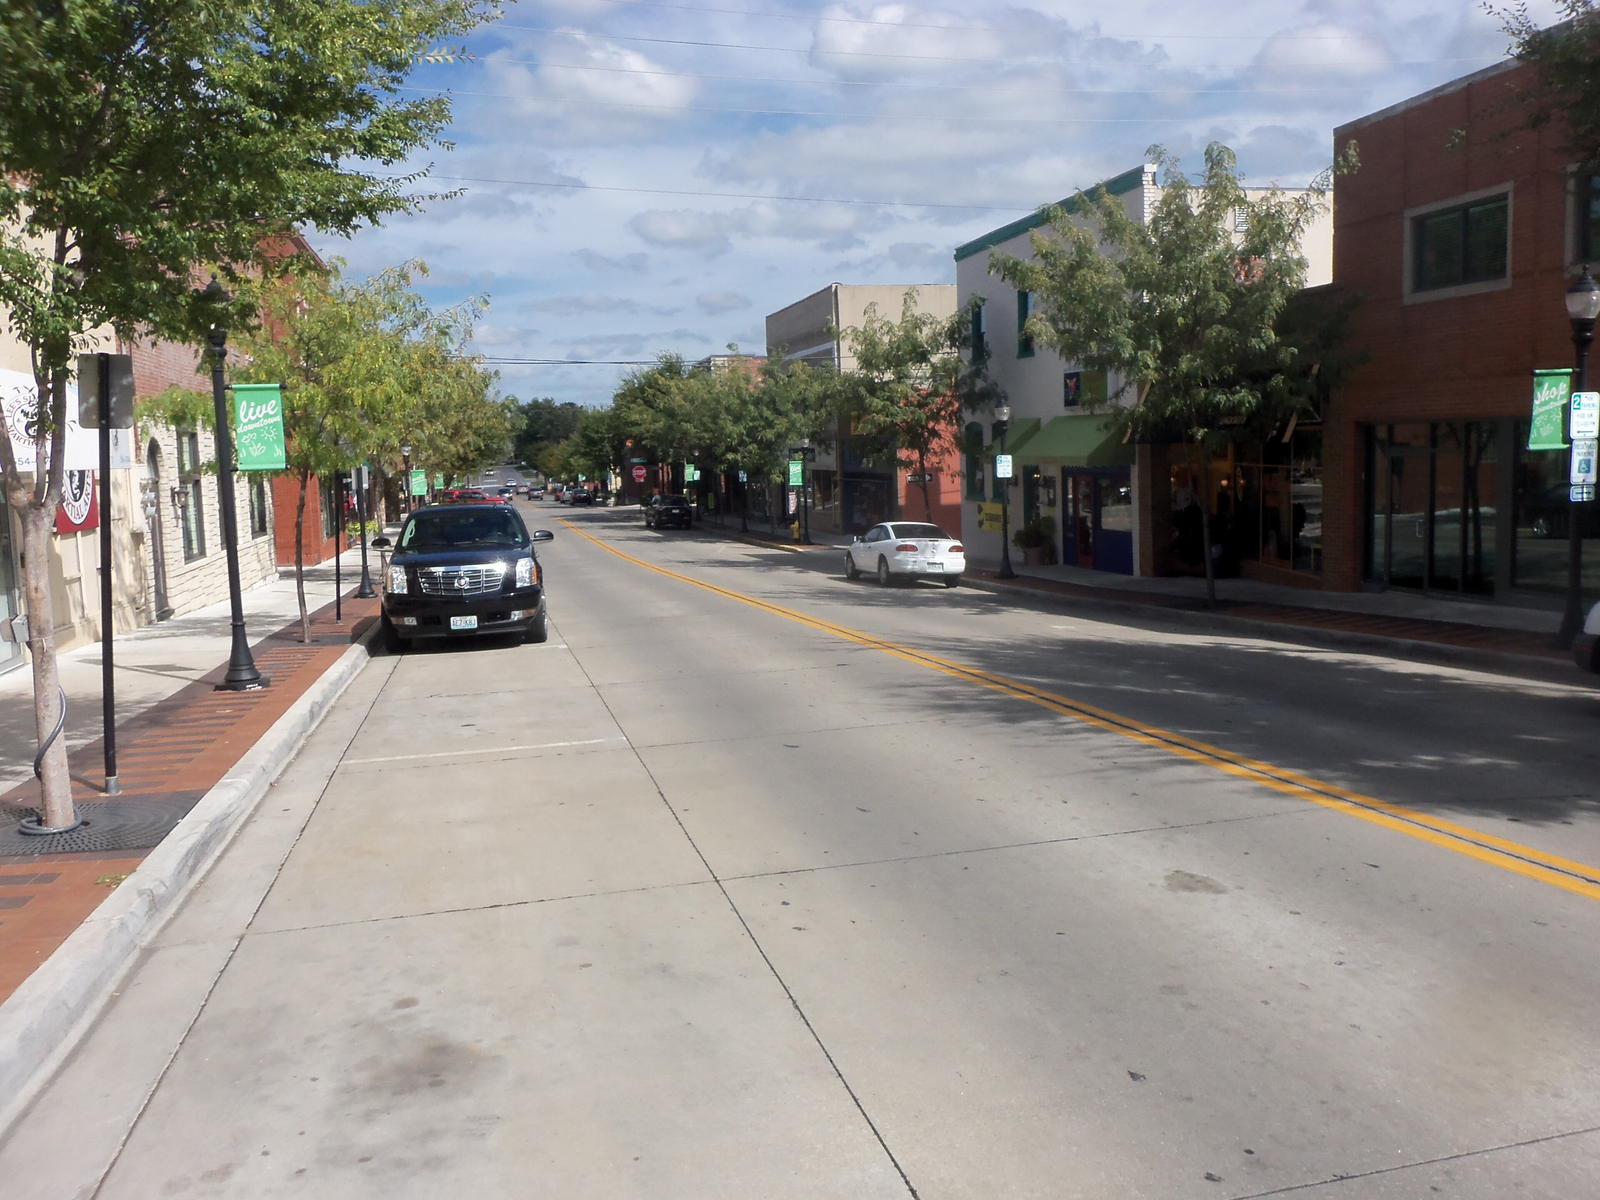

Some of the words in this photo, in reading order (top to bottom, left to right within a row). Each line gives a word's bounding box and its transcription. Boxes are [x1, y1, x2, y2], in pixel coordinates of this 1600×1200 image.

[1535, 382, 1568, 402] shop
[240, 400, 278, 423] live
[1574, 396, 1580, 408] 2
[237, 415, 281, 433] downtown
